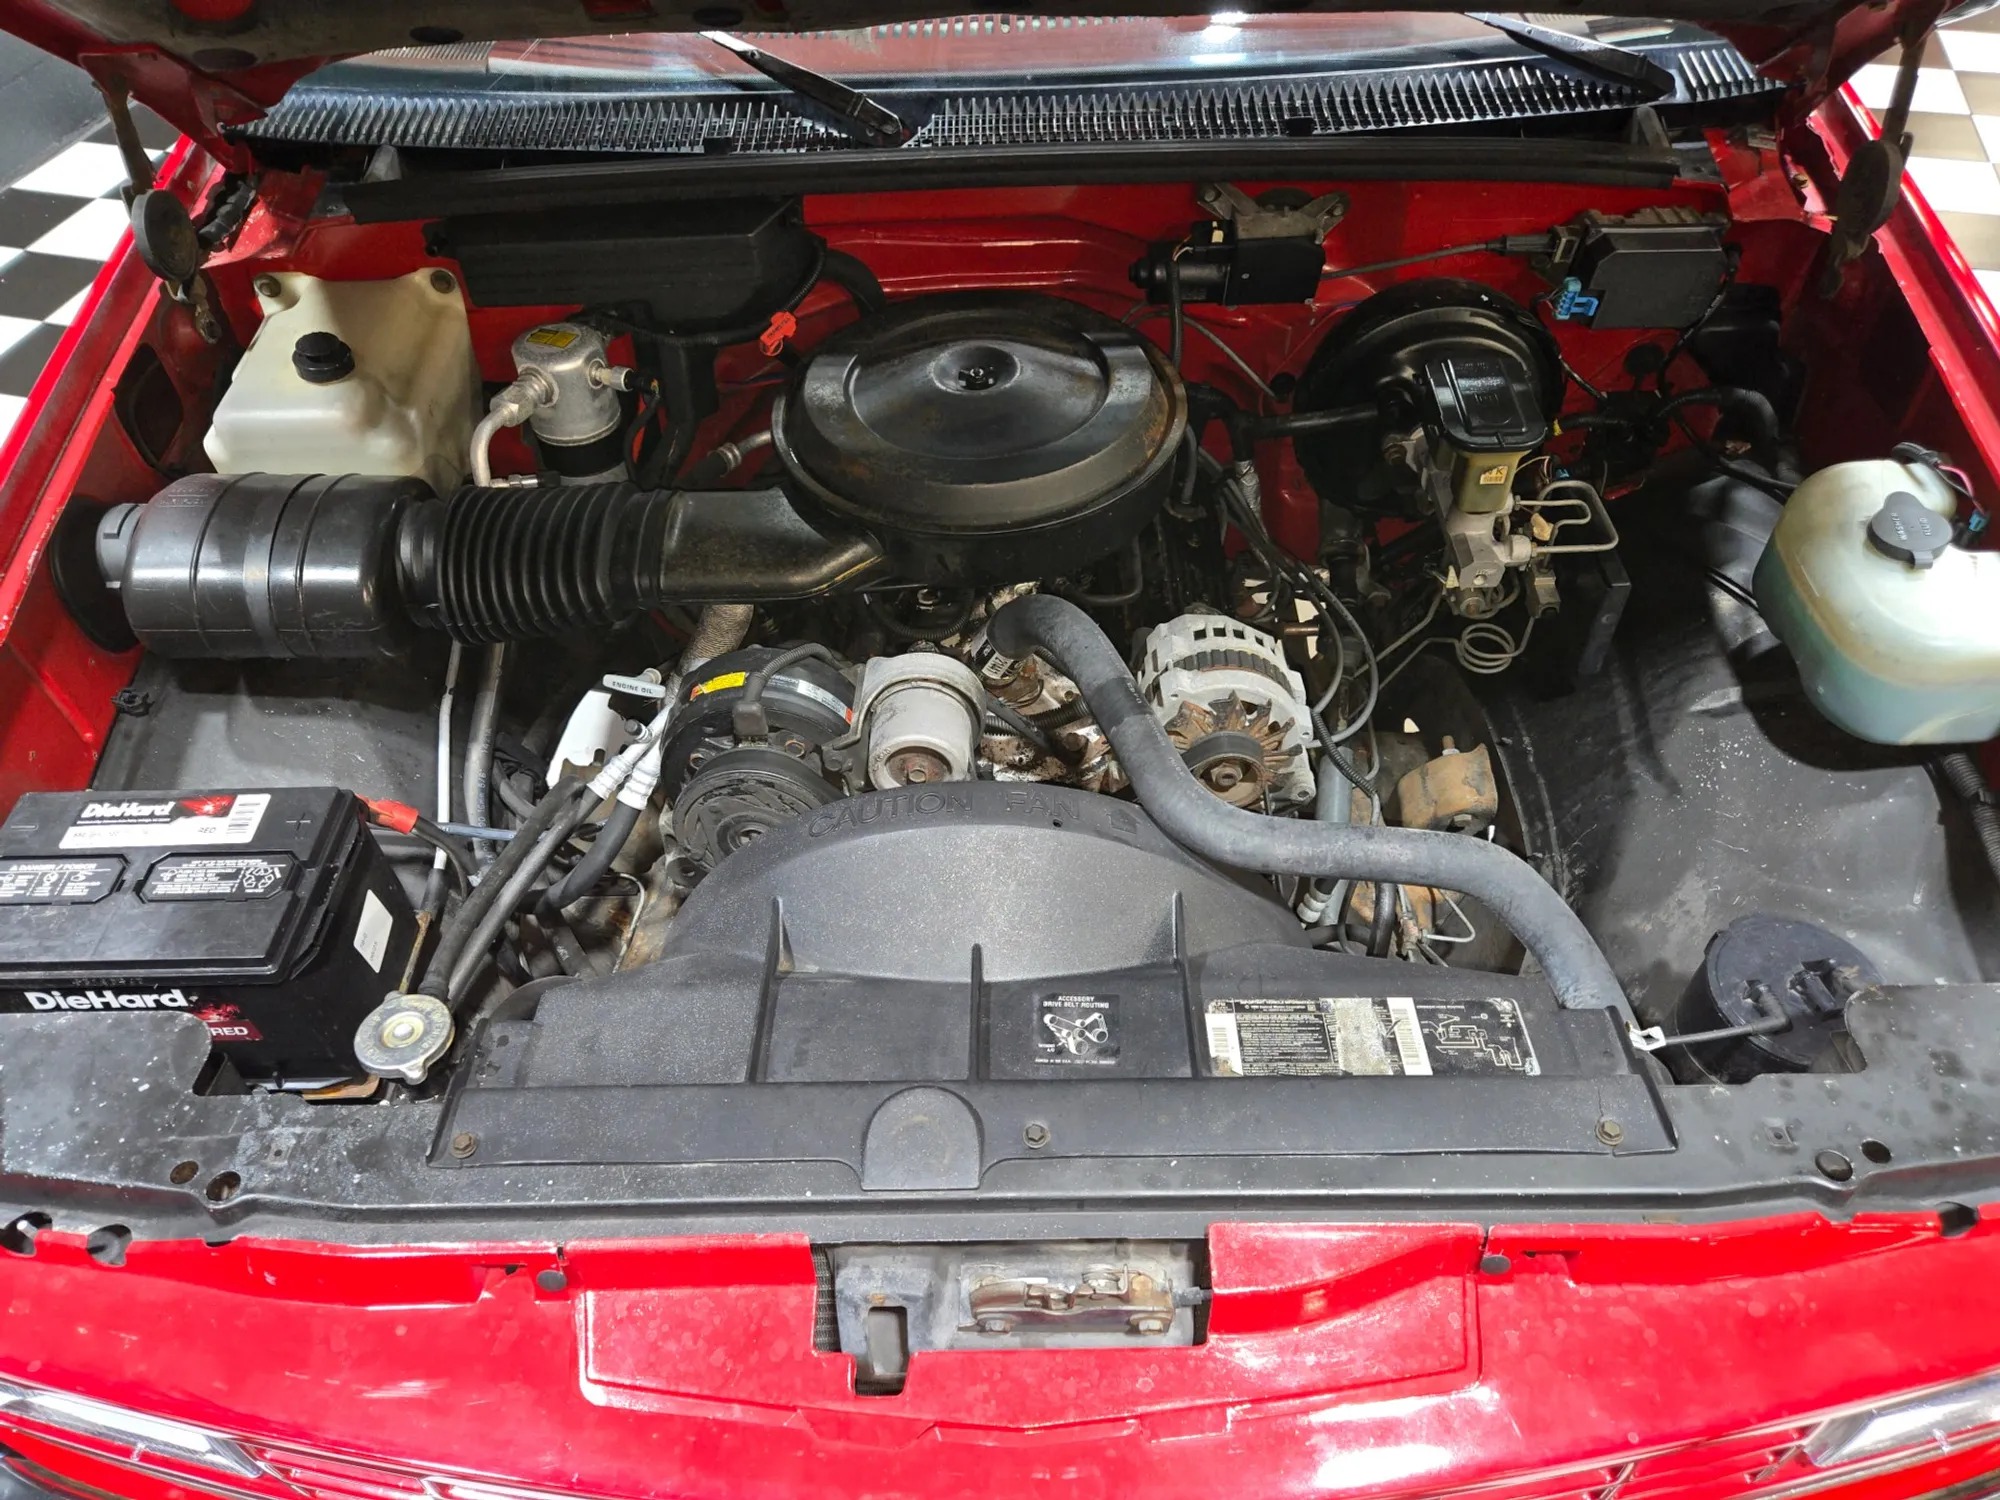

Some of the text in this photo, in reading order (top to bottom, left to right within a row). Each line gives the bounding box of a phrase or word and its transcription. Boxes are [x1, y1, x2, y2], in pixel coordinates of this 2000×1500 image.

[612, 681, 639, 691] ENGINE
[80, 801, 176, 818] DieHard
[808, 790, 1080, 838] CAUTION FAN
[23, 989, 188, 1010] DieHard
